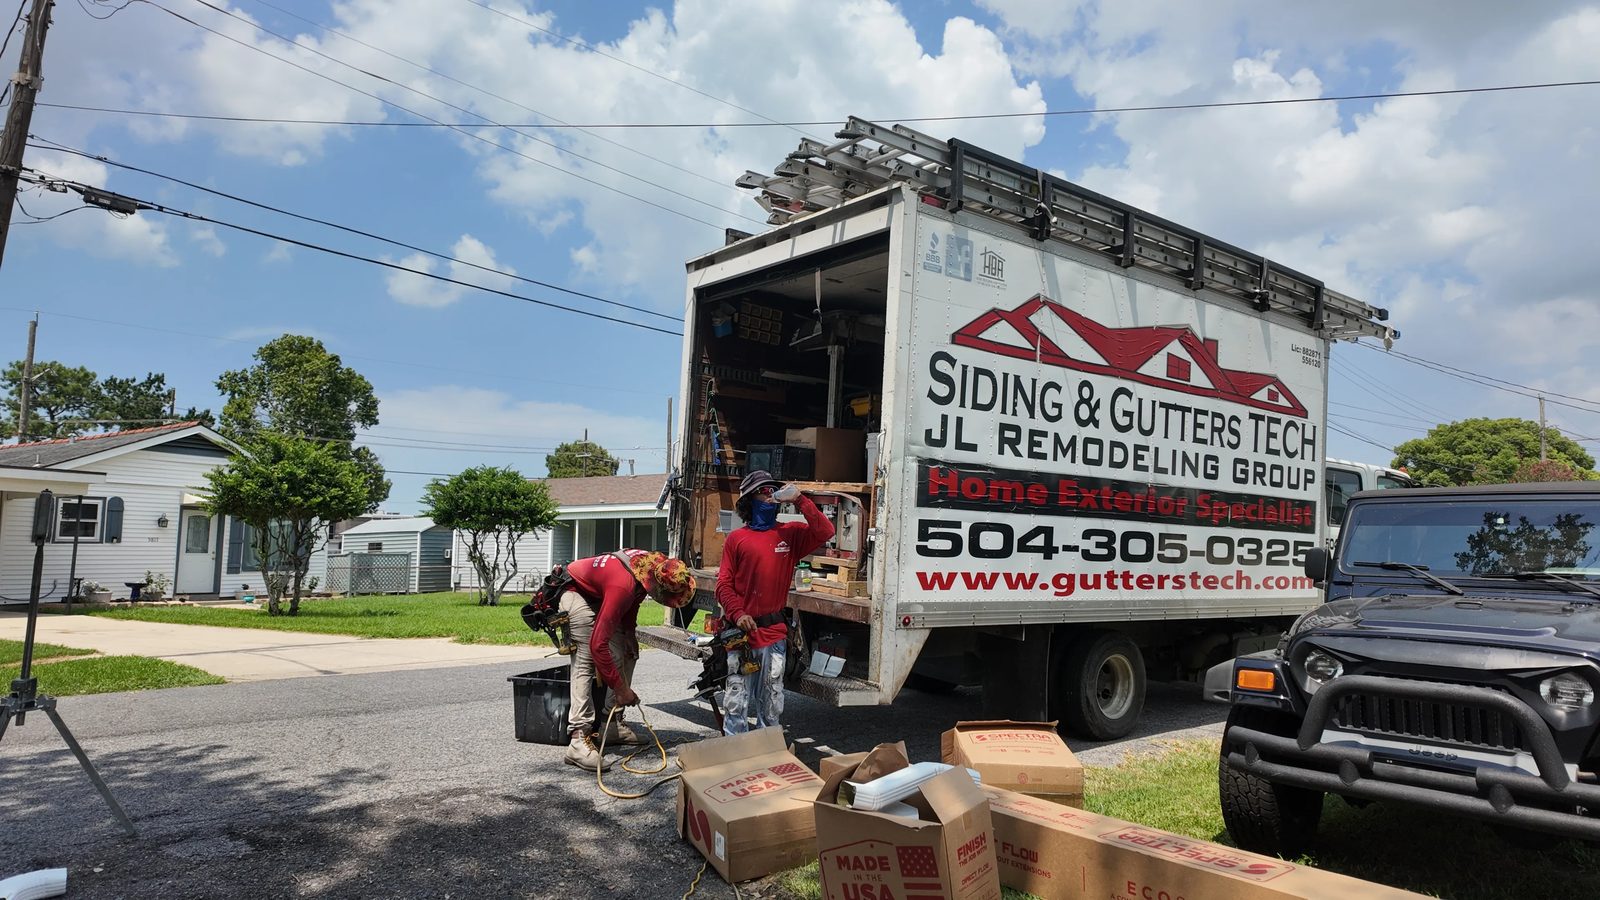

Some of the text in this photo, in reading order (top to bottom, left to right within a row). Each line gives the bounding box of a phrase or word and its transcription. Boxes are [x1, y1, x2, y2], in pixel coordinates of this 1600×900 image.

[925, 253, 941, 263] BBB
[926, 351, 1317, 462] SIDING & GUTTERS TECH
[924, 414, 1316, 492] JL REMODELING GROUP
[927, 466, 1313, 528] Home Exterior Specialist
[915, 519, 1315, 567] 504-305-0325
[915, 569, 1314, 597] www.gutterstech.com
[988, 732, 1051, 741] SPECTRA
[1408, 744, 1458, 761] Jeep
[720, 772, 770, 790] MADE
[730, 779, 782, 797] USA
[956, 831, 987, 861] FINISH
[1001, 841, 1039, 863] FLOW
[1117, 832, 1242, 869] SPECTRA
[835, 855, 891, 871] MADE
[1010, 859, 1052, 879] EXTENSIONS
[853, 873, 883, 882] IN THE
[841, 882, 896, 900] USA
